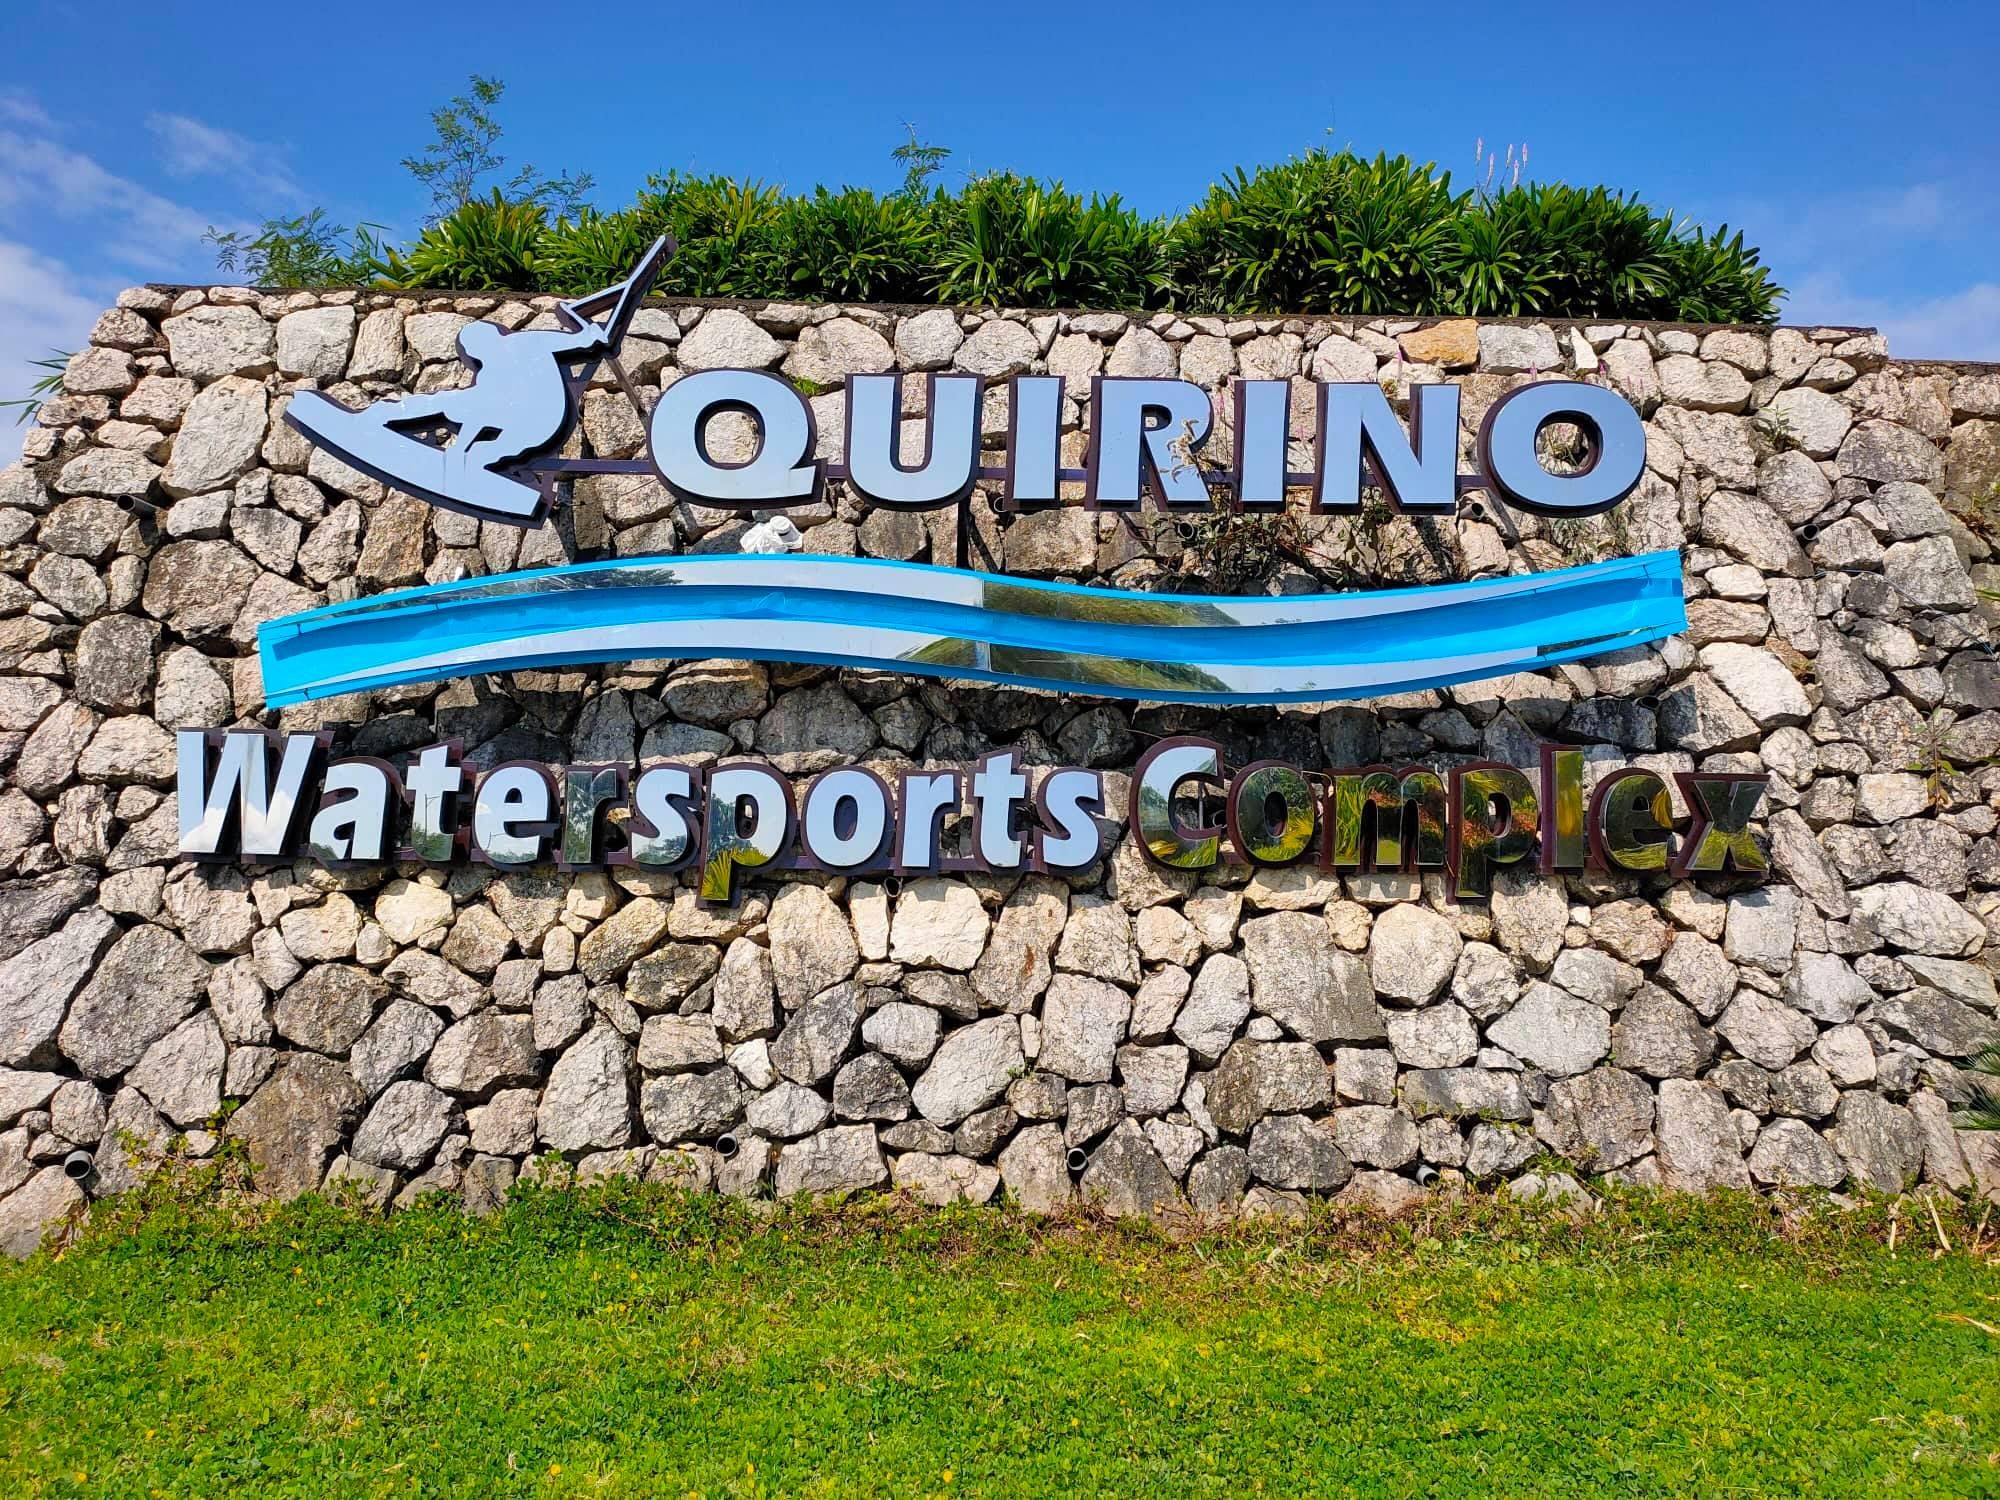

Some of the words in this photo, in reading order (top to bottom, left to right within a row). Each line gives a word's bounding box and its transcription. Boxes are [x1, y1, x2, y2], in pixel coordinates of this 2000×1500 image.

[649, 370, 1647, 511] QUIRINO
[177, 729, 1102, 902] Watersports
[1136, 742, 1770, 898] Complex
